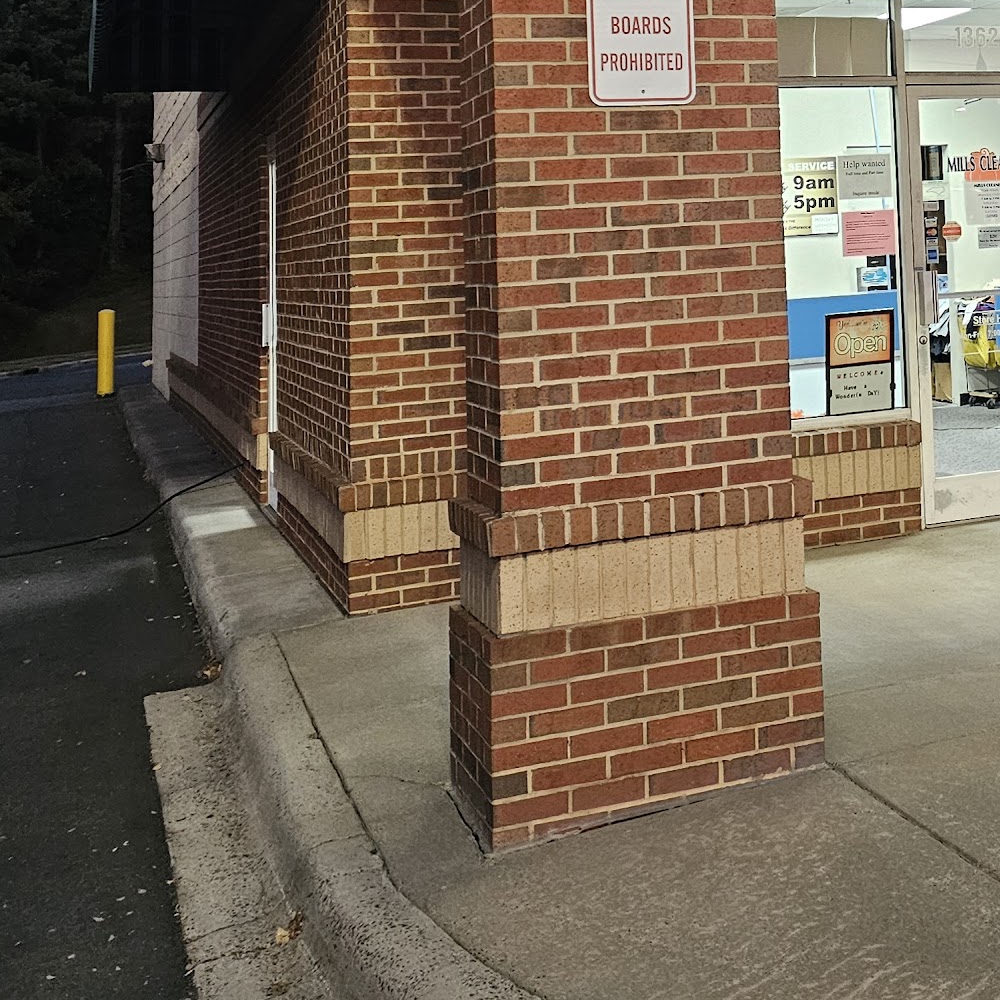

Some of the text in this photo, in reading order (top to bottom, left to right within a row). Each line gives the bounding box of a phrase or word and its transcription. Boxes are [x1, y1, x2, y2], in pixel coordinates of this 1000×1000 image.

[611, 16, 672, 35] BOARDS
[600, 52, 683, 72] PROHIBITED
[788, 161, 835, 172] SERVICE
[843, 158, 886, 170] Help wanted
[947, 156, 976, 173] MILLS
[793, 175, 835, 190] 9am
[793, 195, 835, 212] 5pm
[973, 315, 995, 325] Store
[834, 331, 888, 359] Open
